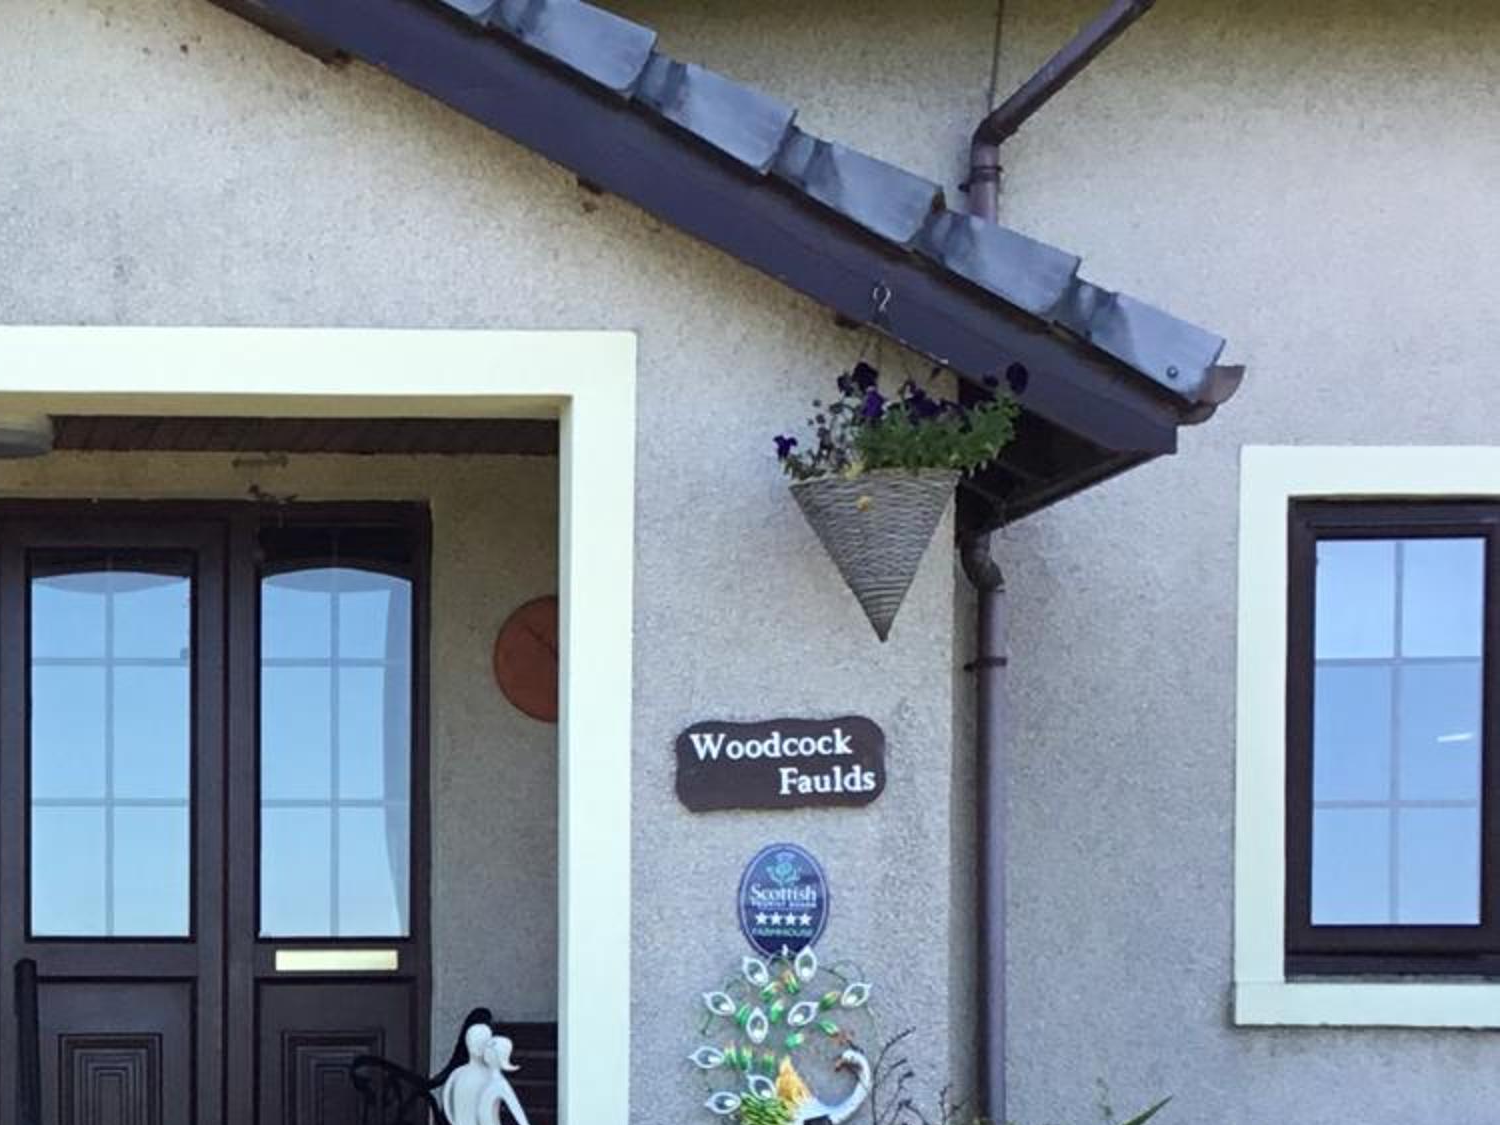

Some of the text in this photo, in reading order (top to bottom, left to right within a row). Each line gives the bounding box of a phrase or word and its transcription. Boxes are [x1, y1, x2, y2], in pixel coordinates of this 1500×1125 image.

[689, 727, 853, 761] Woodcock
[778, 764, 876, 795] Faulds
[751, 883, 818, 902] Scottish
